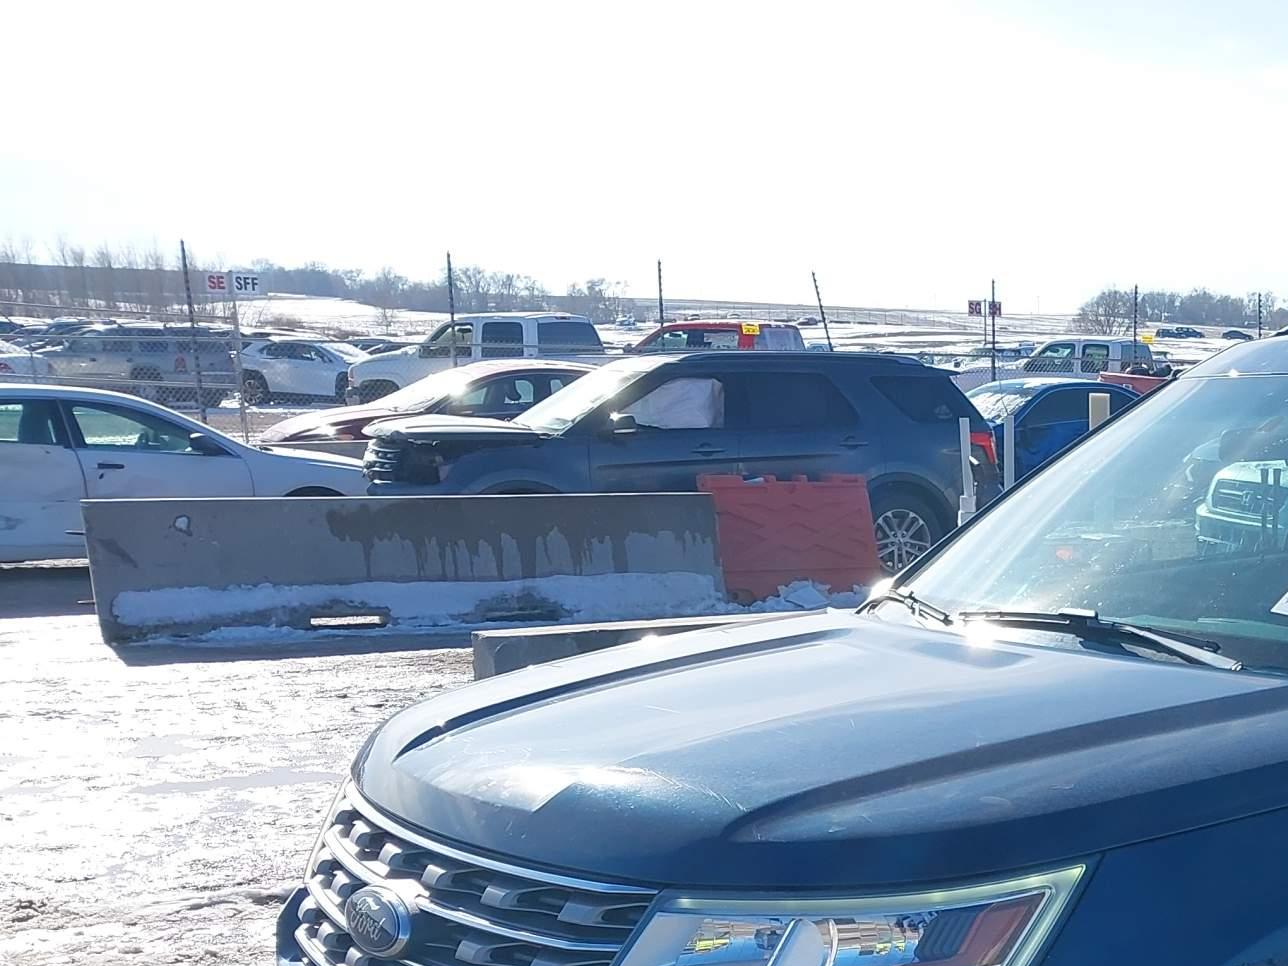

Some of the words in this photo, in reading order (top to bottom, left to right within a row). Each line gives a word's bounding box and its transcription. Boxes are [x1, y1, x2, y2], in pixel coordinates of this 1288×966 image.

[207, 274, 226, 290] SE
[235, 275, 259, 291] SFF
[349, 896, 387, 941] Ford
